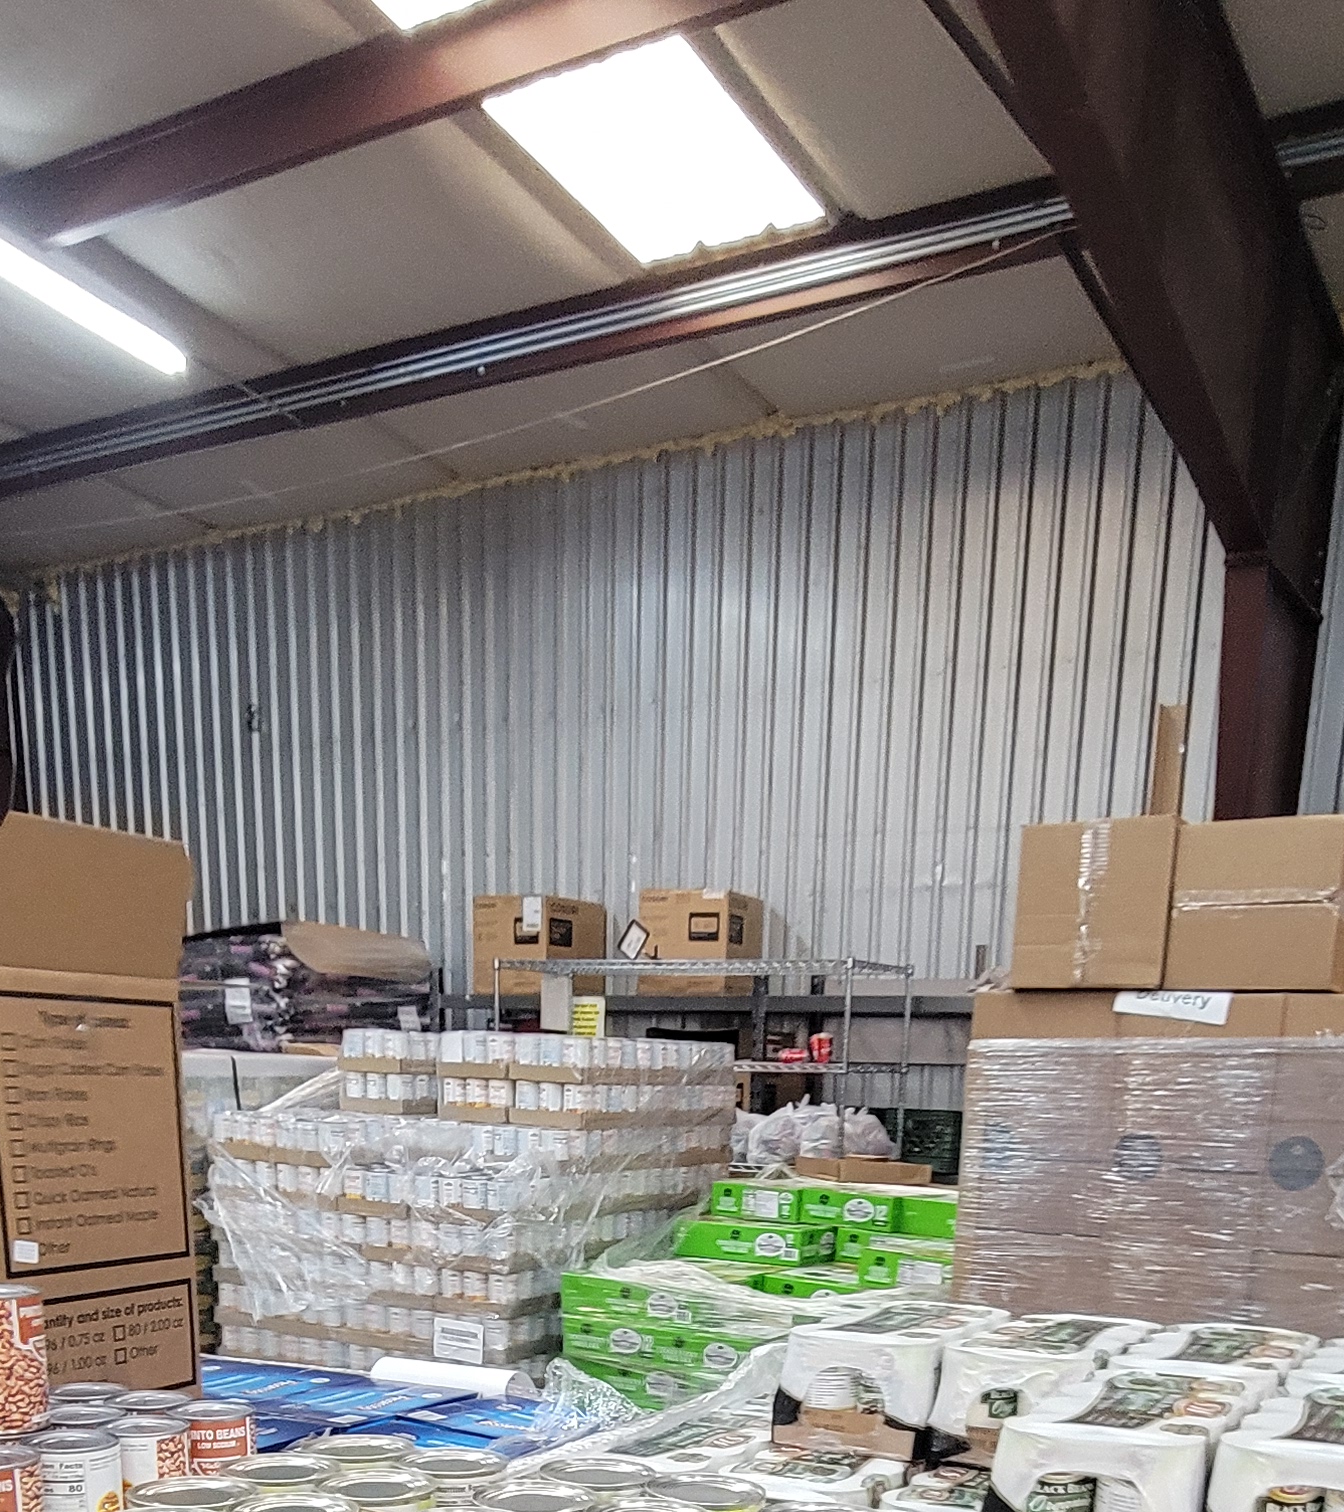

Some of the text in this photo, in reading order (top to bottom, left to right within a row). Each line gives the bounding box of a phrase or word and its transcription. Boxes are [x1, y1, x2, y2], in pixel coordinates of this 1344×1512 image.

[76, 1310, 100, 1325] and
[101, 1306, 123, 1321] size
[123, 1302, 135, 1316] of
[172, 1317, 184, 1329] oz
[95, 1354, 107, 1367] oz
[216, 1426, 246, 1440] BEANS
[197, 1441, 212, 1450] LOW
[58, 1461, 84, 1471] Facts
[68, 1484, 84, 1494] 80
